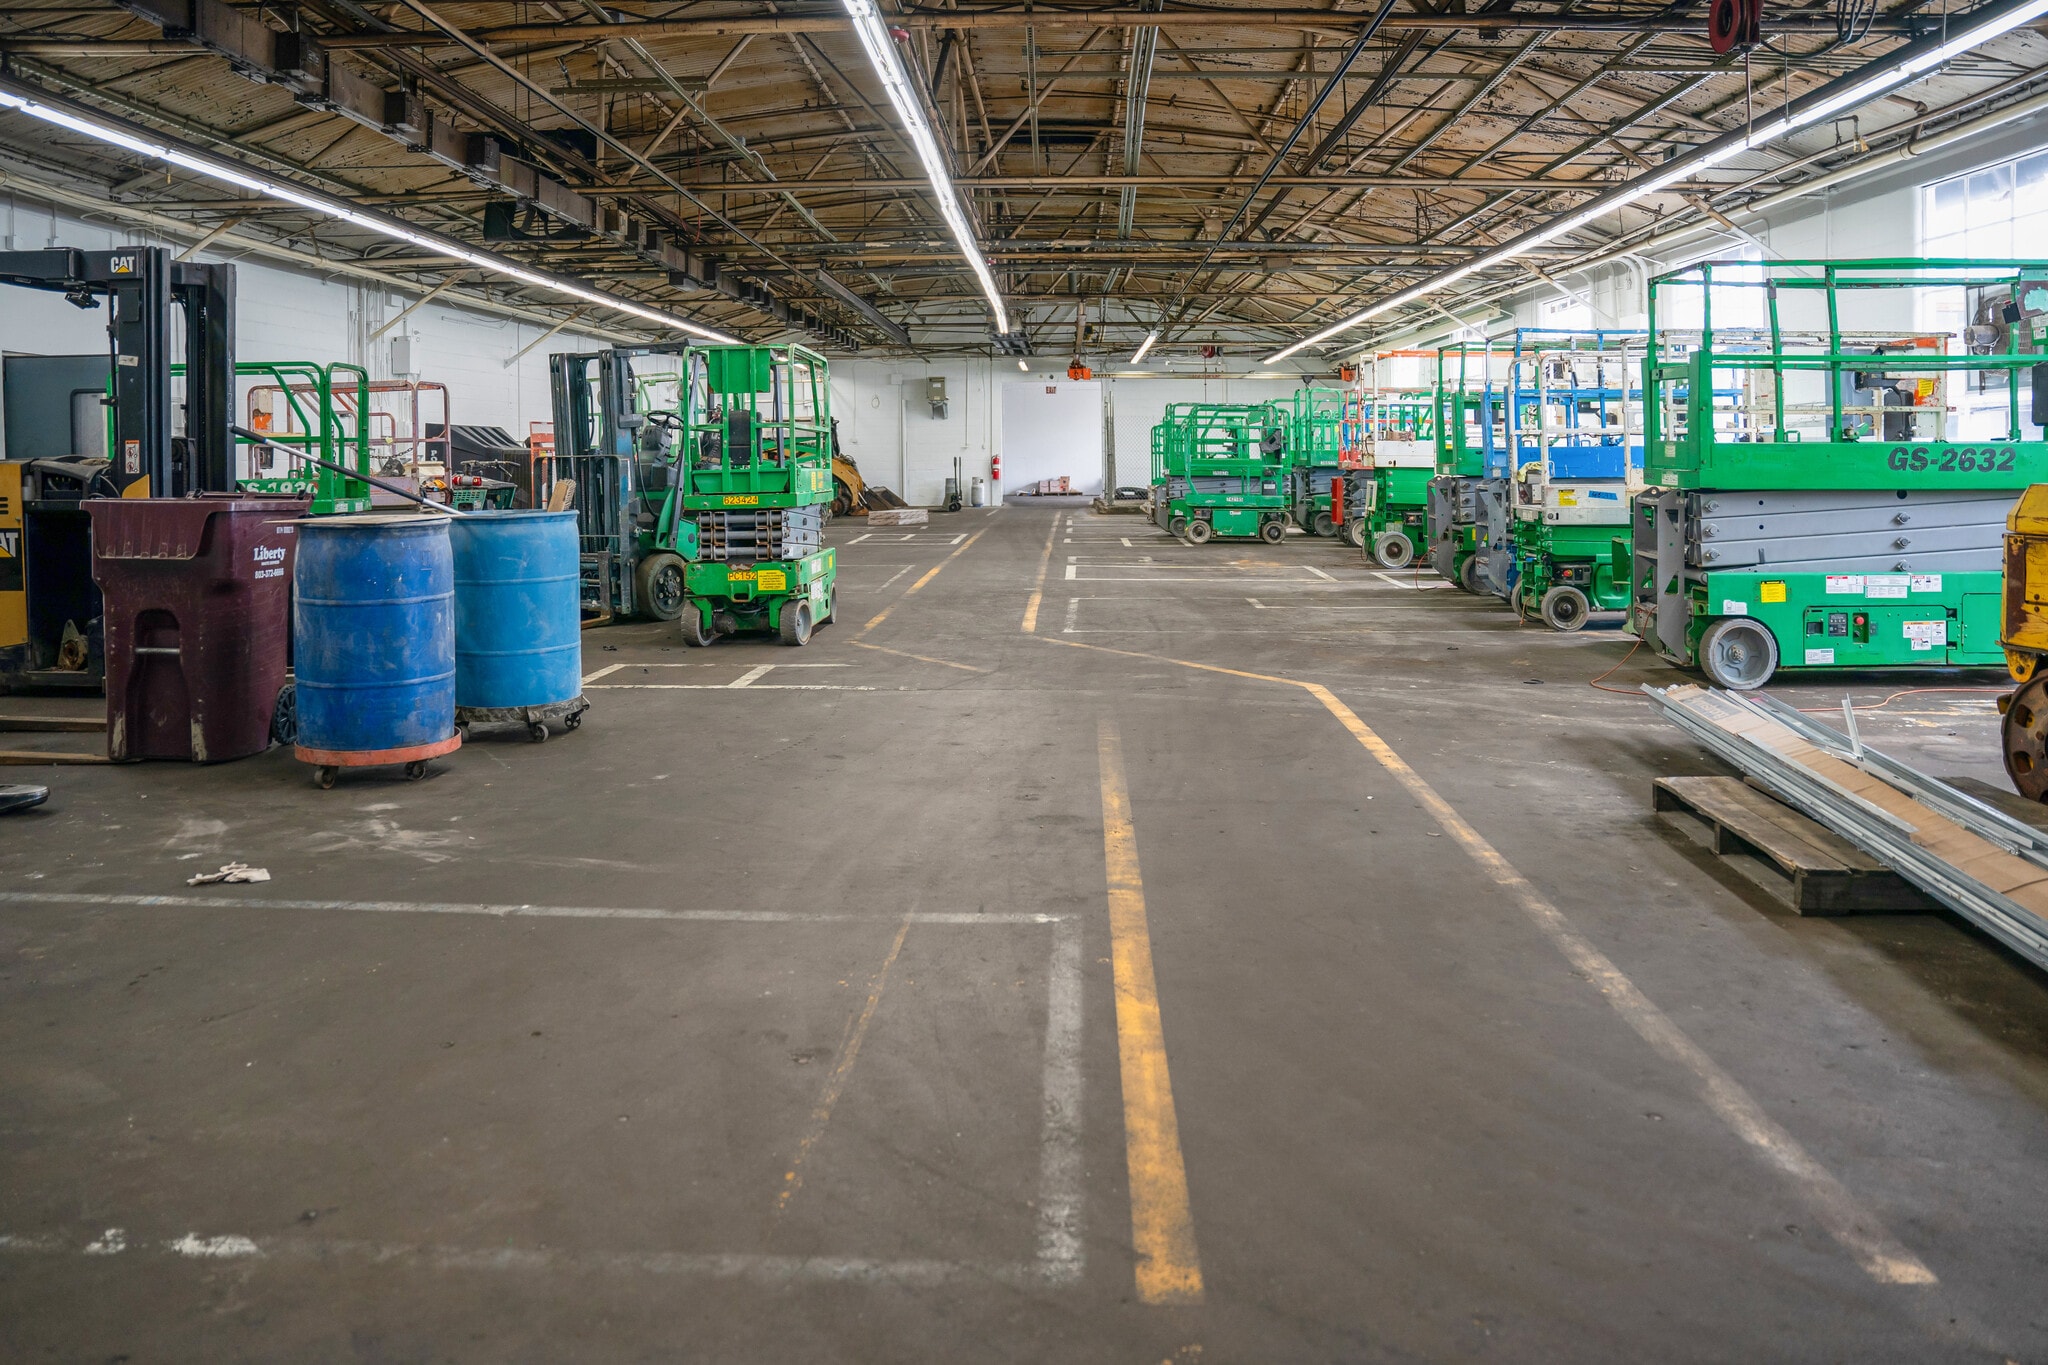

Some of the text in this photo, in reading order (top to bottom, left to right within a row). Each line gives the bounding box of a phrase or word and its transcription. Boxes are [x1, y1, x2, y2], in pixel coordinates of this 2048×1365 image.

[110, 256, 135, 273] CAT
[1887, 446, 2017, 473] GS-2632
[236, 481, 318, 494] S-1930
[724, 495, 758, 504] 623424
[0, 532, 18, 557] AT
[253, 545, 286, 560] Liberty
[728, 571, 756, 580] PC152
